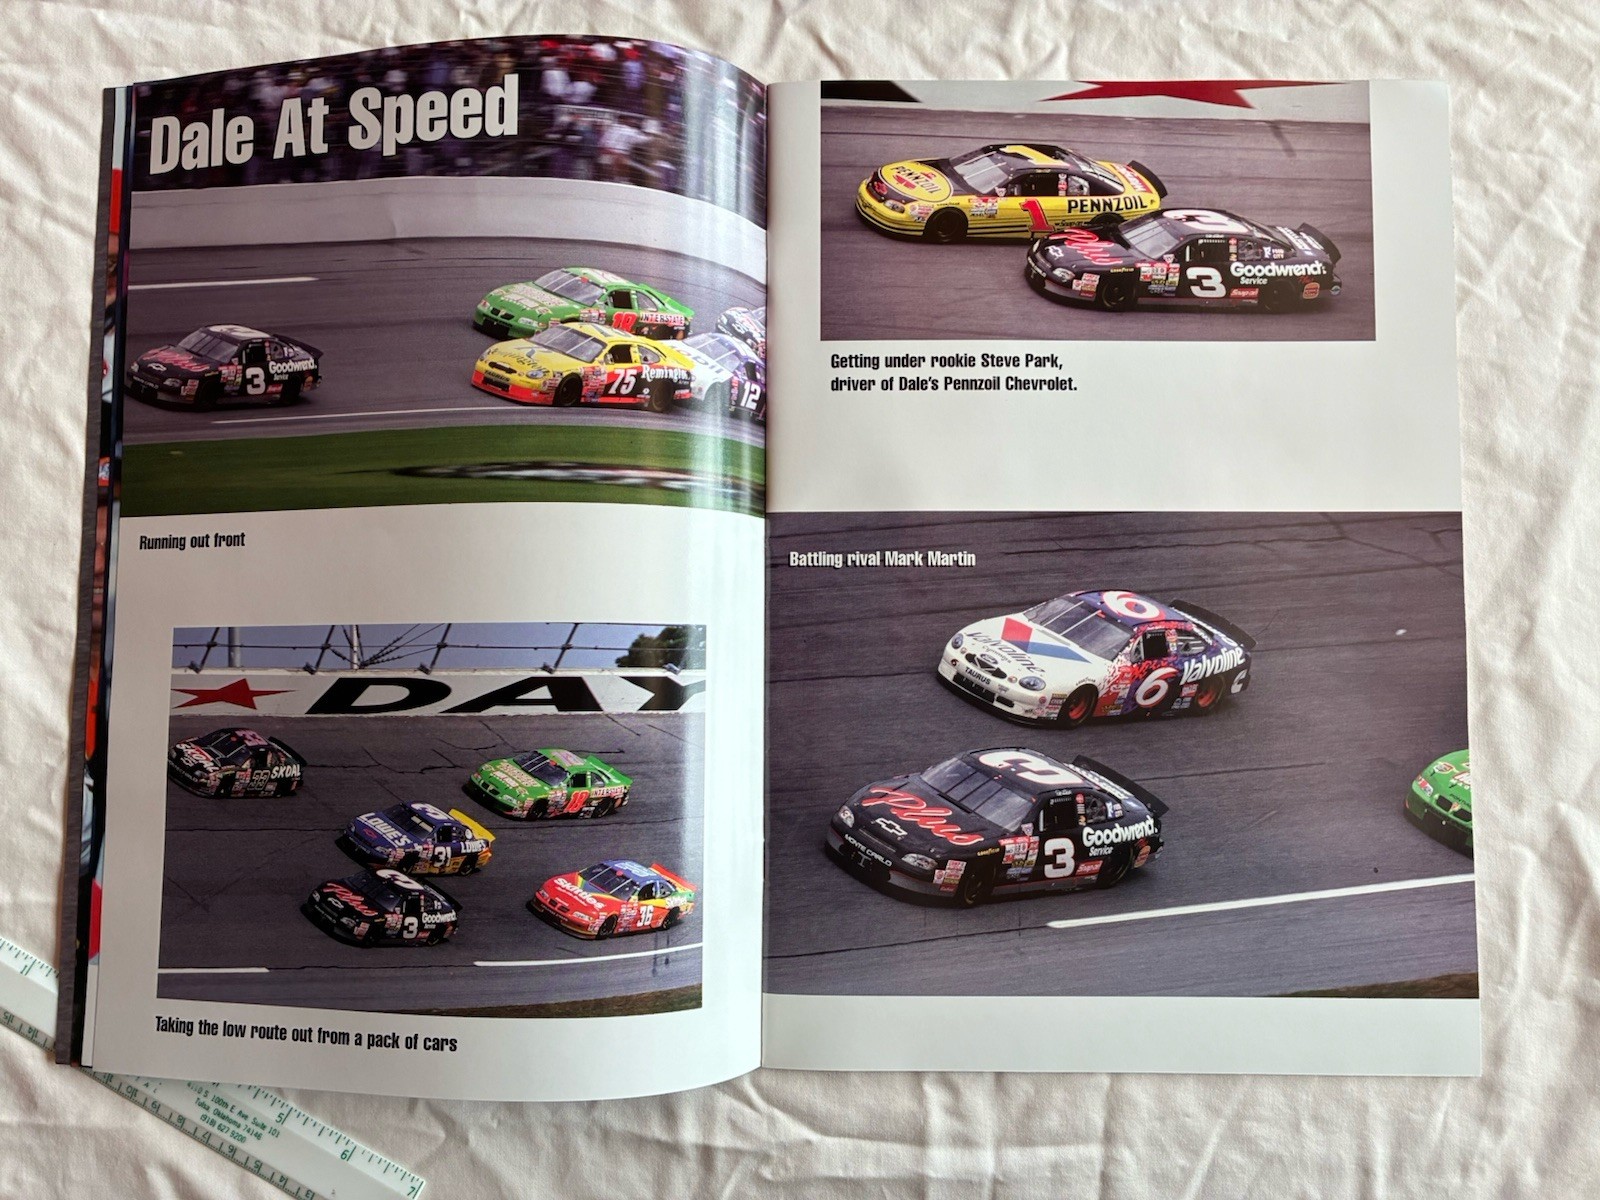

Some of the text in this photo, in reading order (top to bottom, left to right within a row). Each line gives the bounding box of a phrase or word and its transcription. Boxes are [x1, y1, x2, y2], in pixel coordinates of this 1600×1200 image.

[149, 73, 519, 175] Dale At Speed
[1019, 198, 1055, 232] 1
[1067, 196, 1148, 213] PENNZOIL
[1186, 266, 1226, 298] 3
[1240, 276, 1268, 285] Service
[640, 313, 685, 326] INTERSTATE
[831, 353, 1063, 370] Getting under rookie Steve Park,
[245, 367, 266, 395] 3
[608, 368, 638, 395] 75
[831, 376, 1077, 391] driver of Dale's Pennzoil Chevrolet.
[740, 380, 762, 410] 12
[139, 532, 246, 551] Running out front
[789, 551, 977, 568] Battling rival Mark Martin
[1103, 591, 1166, 620] 6
[966, 631, 1046, 673] Valvoline
[964, 666, 992, 685] TAURUS
[1179, 647, 1246, 685] Valvoline
[1136, 667, 1179, 707] 6
[271, 764, 302, 779] SKOAL
[979, 751, 1085, 785] 3
[564, 789, 591, 813] 18
[862, 787, 984, 846] Plus
[359, 812, 413, 847] LOWE'S
[433, 846, 452, 867] 31
[844, 833, 893, 867] MONTE CARLO
[1044, 837, 1075, 878] 3
[1089, 845, 1114, 857] Service
[554, 878, 607, 911] Skittles
[402, 916, 418, 939] 3
[637, 905, 655, 927] 36
[155, 1016, 458, 1052] Taking the low route out from a pack of cars
[200, 1113, 217, 1128] (918)
[216, 1122, 230, 1134] 627
[213, 1108, 242, 1129] Oklahoma
[251, 1117, 267, 1131] Suite
[268, 1126, 281, 1138] 101
[275, 1112, 285, 1123] 5
[340, 1150, 350, 1160] 6
[407, 1186, 416, 1196] 7
